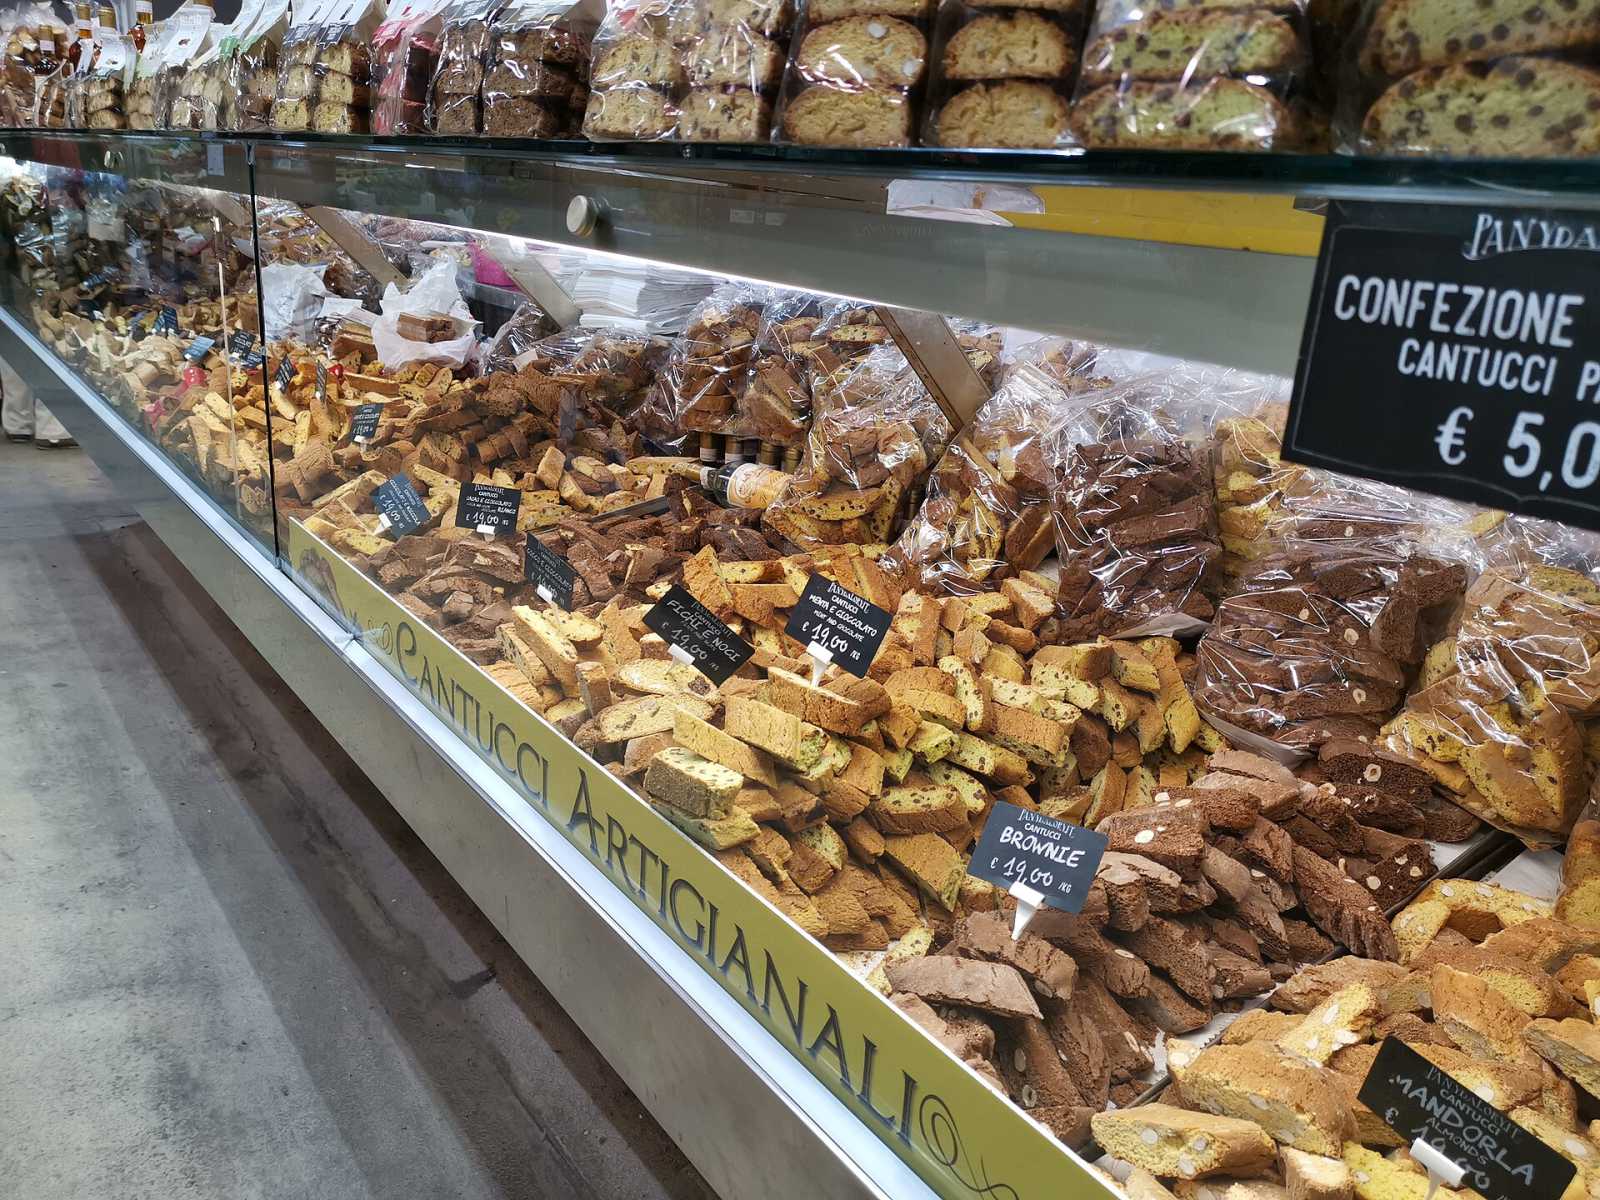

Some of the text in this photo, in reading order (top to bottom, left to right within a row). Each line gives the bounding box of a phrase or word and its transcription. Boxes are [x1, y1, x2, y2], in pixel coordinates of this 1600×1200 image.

[1334, 275, 1584, 348] CONFEZIONE
[1397, 338, 1600, 404] CANTUCCI P
[1434, 406, 1474, 466] €
[808, 594, 877, 637] MENTA E CIOCCOLATO
[831, 595, 859, 614] CANTUCCI
[667, 600, 703, 630] FICHI
[702, 629, 714, 639] E
[712, 637, 740, 662] NOCI
[671, 629, 708, 659] 19,00
[811, 623, 848, 652] 19,00
[1000, 826, 1086, 868] BROWNIE
[1024, 823, 1061, 840] CANTUCCI
[396, 622, 918, 1150] CANTUCCI ARTIGIANALI
[990, 857, 998, 869] €
[1003, 857, 1053, 887] 19,00
[1385, 1107, 1399, 1125] €
[1389, 1075, 1534, 1186] MANDORLA
[1440, 1089, 1500, 1135] CANTUCCI
[1426, 1116, 1489, 1165] ALMONDS
